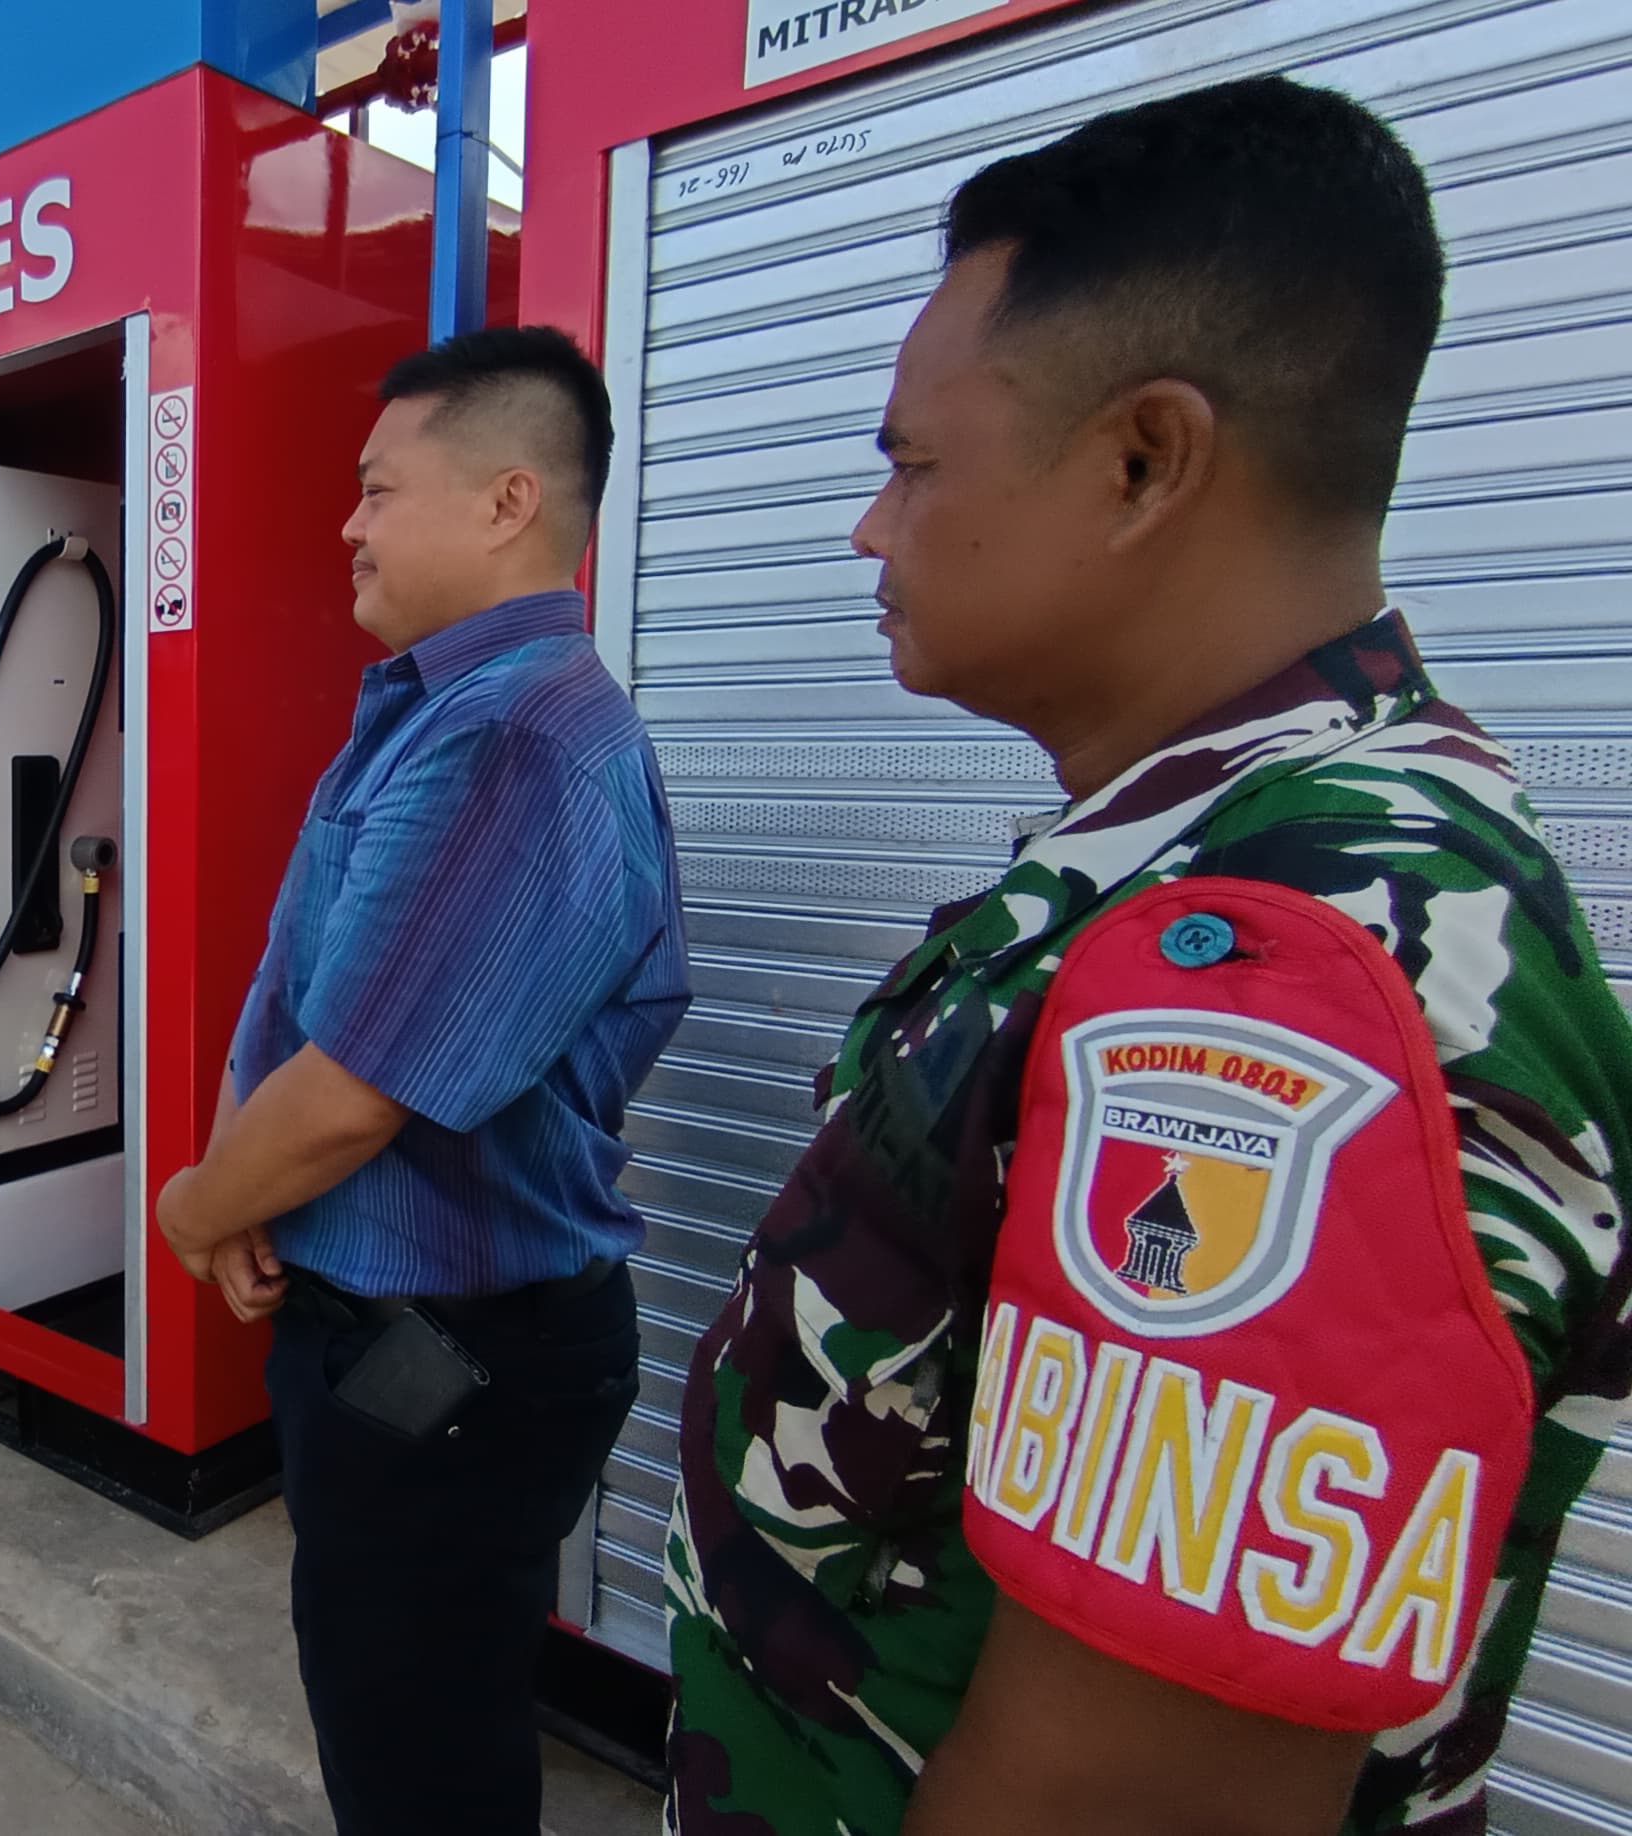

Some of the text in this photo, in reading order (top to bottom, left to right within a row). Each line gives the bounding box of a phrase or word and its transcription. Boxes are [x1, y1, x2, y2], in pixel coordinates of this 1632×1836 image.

[1106, 1043, 1309, 1108] KODIM 0803
[1103, 1107, 1278, 1160] BRAWIJAYA
